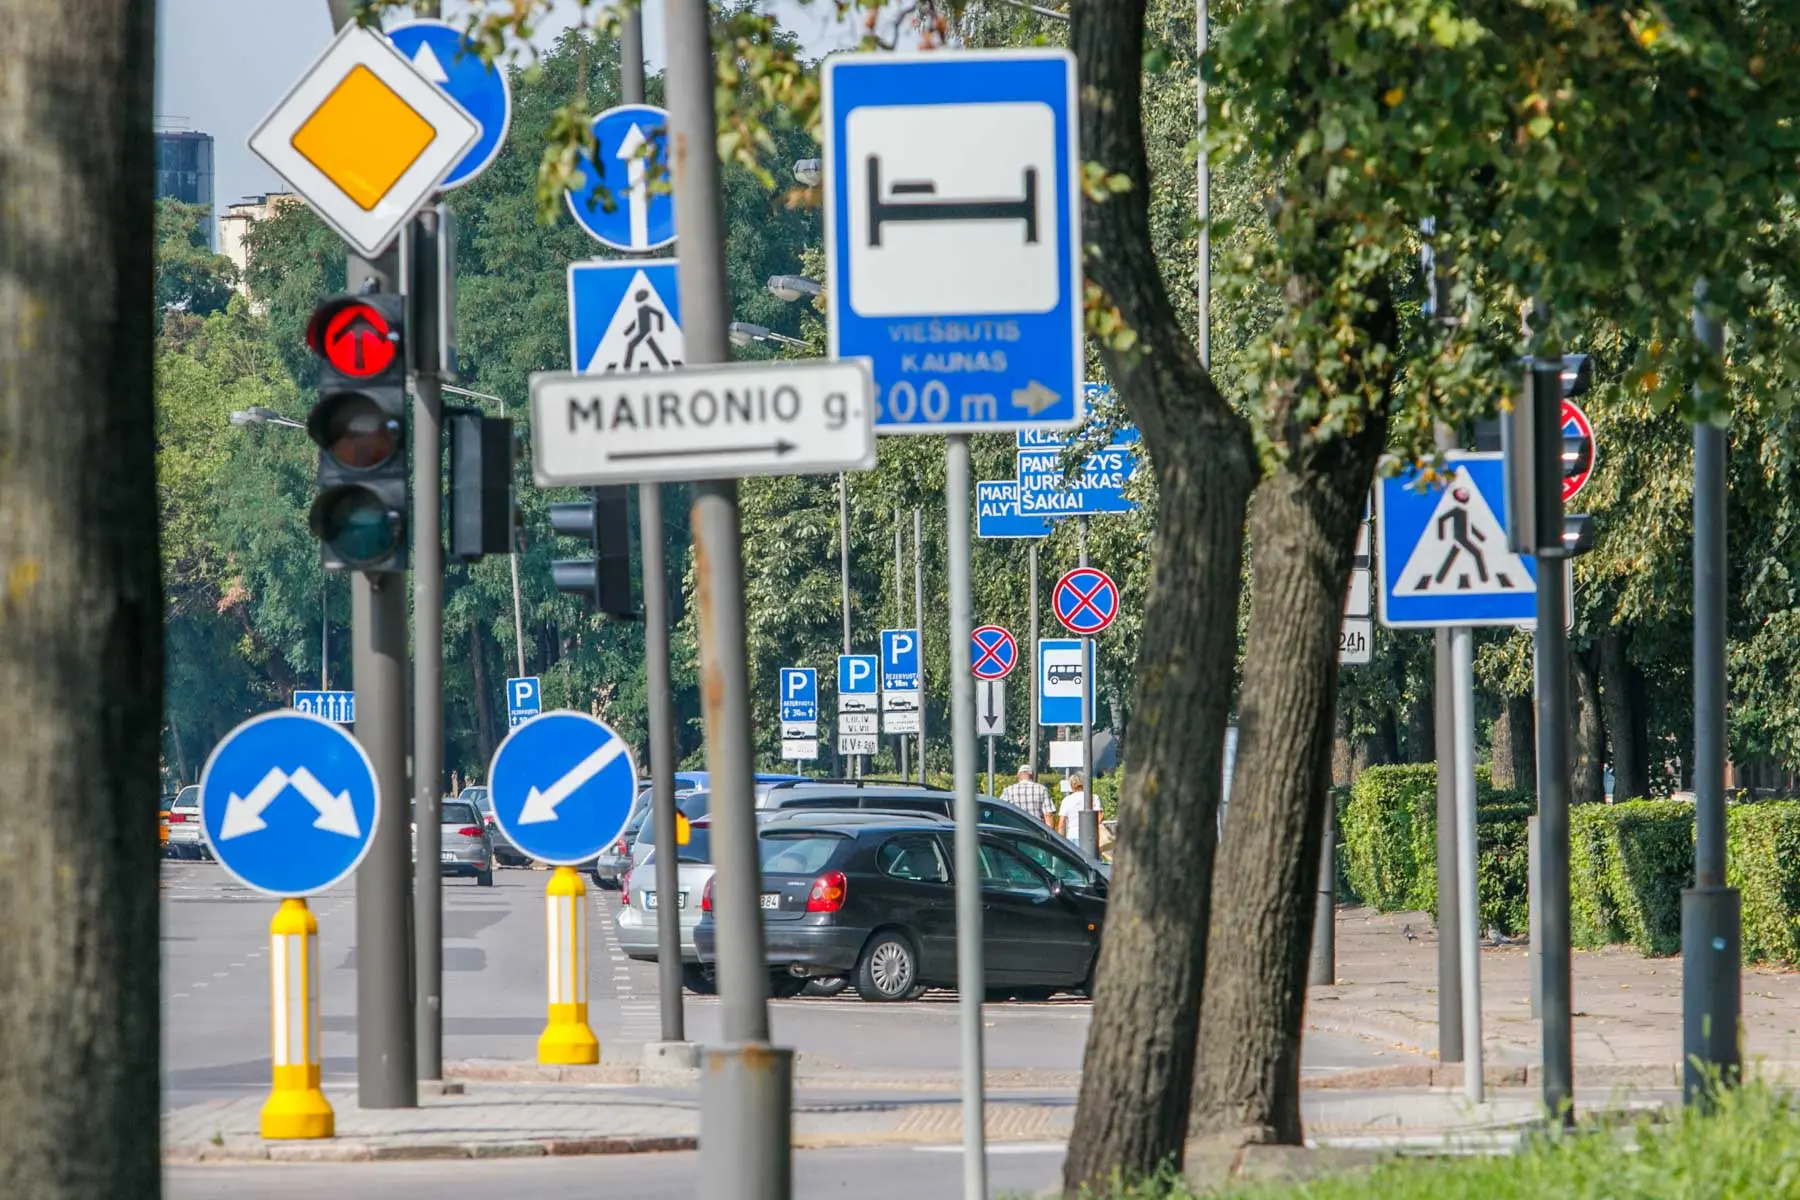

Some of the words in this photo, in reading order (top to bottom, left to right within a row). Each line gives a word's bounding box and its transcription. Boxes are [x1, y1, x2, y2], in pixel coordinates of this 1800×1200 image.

[888, 318, 1020, 343] VIEŠBUTIS
[902, 350, 1007, 373] KAUNAS
[567, 384, 803, 434] MAIRONIO
[822, 391, 862, 430] g.
[960, 393, 997, 422] m
[1022, 490, 1083, 510] ŠAKIAI
[1337, 631, 1365, 651] 24h
